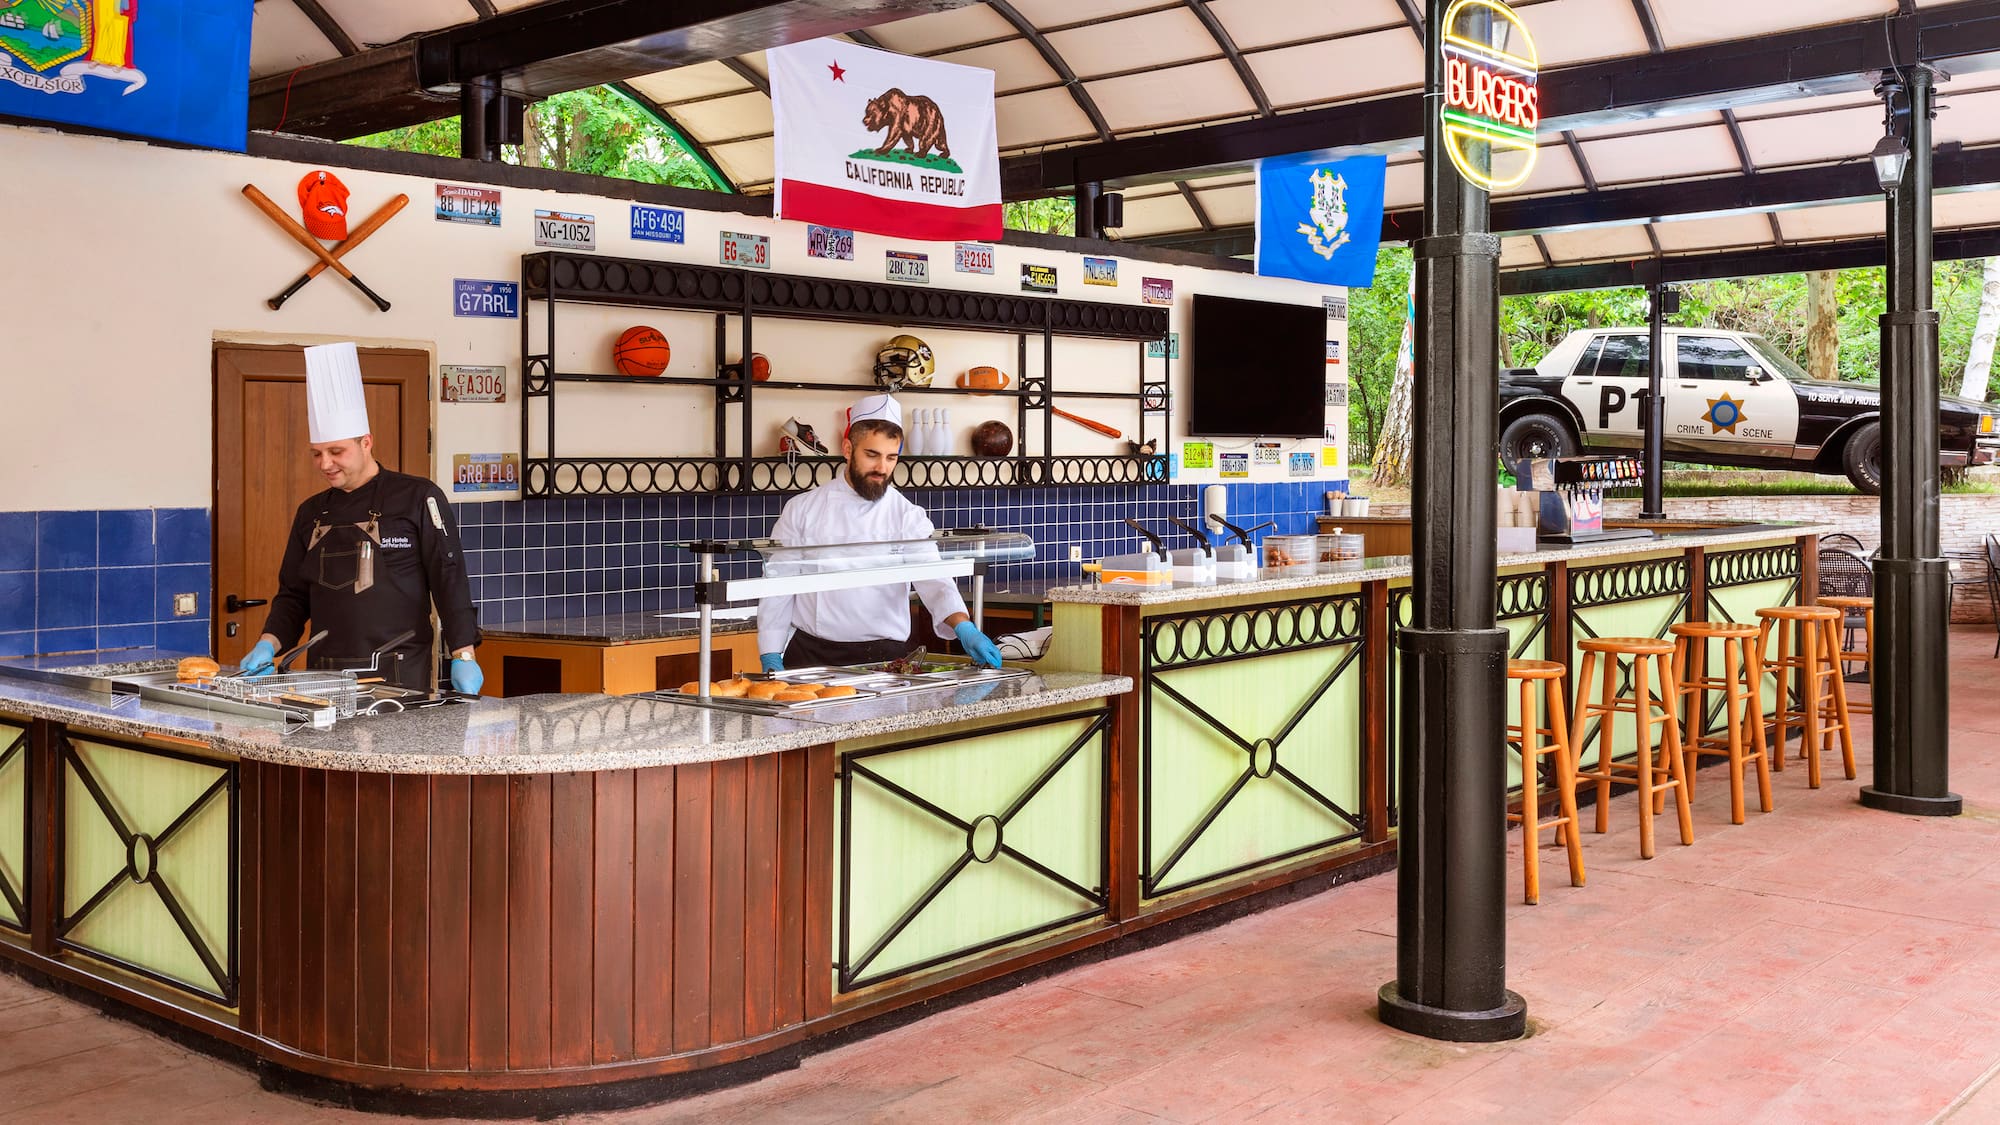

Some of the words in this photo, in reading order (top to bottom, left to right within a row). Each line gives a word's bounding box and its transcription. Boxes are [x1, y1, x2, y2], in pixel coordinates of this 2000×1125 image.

[0, 66, 82, 91] XCELSIOR
[1447, 58, 1538, 129] BURGERS
[845, 160, 914, 191] CALIFORNIA
[920, 175, 965, 196] REPUBLIC
[462, 197, 497, 217] DE129
[539, 220, 590, 242] NG-1052
[645, 231, 672, 239] MISSOURI
[736, 232, 753, 240] TEXAS
[724, 240, 737, 261] EG
[754, 244, 766, 264] 39
[835, 235, 852, 253] 269
[889, 259, 906, 275] 2BC
[908, 262, 925, 277] 732
[970, 251, 993, 269] 2161
[499, 286, 513, 294] 1950
[459, 292, 514, 314] G7RRL
[466, 374, 502, 395] A306
[1599, 385, 1650, 431] P1
[1807, 392, 1817, 402] TO
[1818, 393, 1839, 404] SERVE
[1839, 394, 1854, 406] AND
[1676, 424, 1705, 436] CRIME
[1742, 427, 1773, 440] SCENE
[458, 463, 483, 485] GR8
[490, 463, 514, 482] PL8
